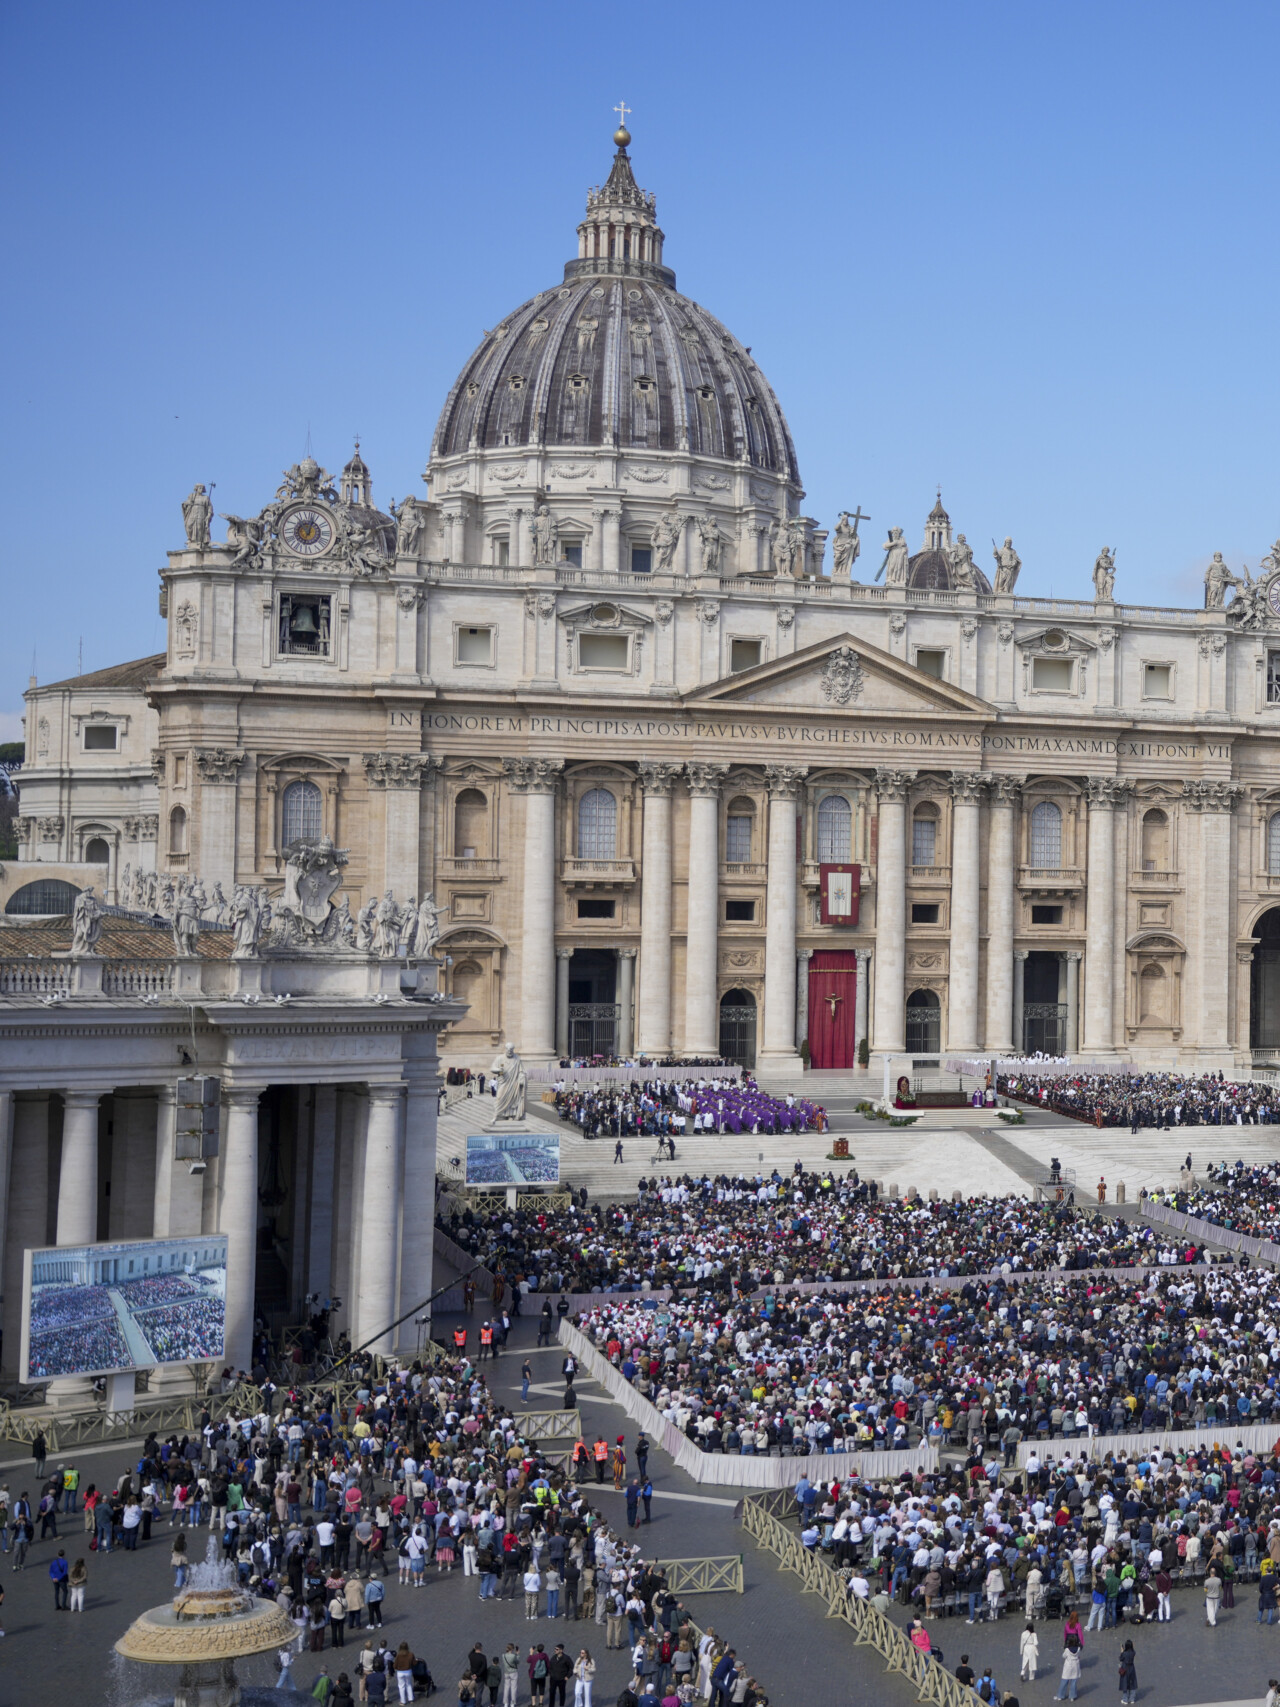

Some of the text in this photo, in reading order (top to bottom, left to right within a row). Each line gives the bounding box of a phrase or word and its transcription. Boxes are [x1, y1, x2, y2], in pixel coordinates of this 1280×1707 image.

[390, 712, 1229, 758] IN HONOREM PRINCIPIS APOST PAVLVS V BVRGHESIVS ROMANVS PONT MAX AN MDCXII PONT VII
